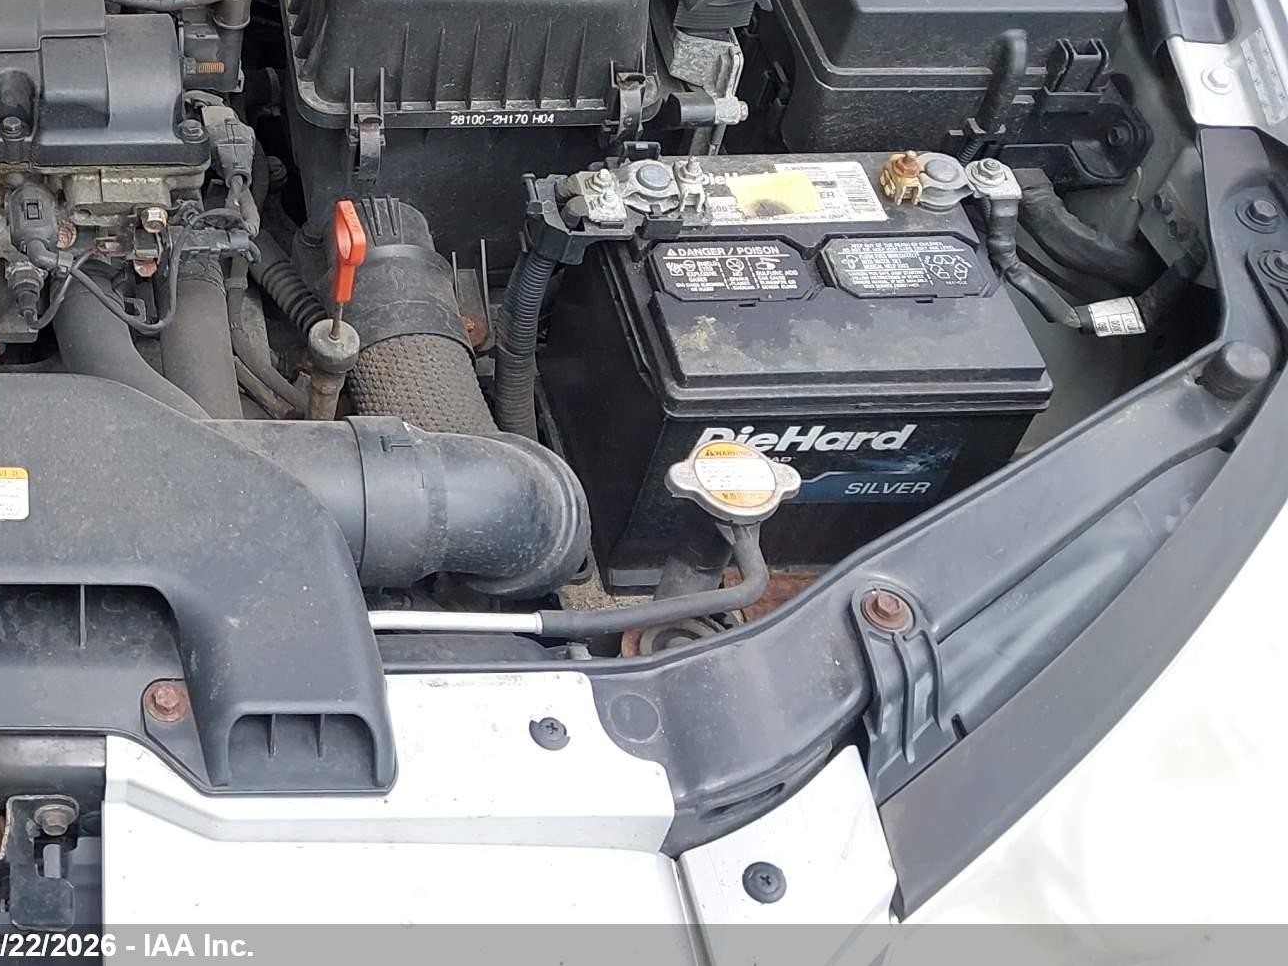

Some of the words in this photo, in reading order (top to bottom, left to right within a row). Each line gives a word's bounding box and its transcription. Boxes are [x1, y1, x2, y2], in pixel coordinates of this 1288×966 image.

[450, 114, 529, 125] 28100-2H170
[532, 113, 555, 124] H04
[678, 247, 725, 257] DANGER
[737, 246, 780, 255] POISON
[695, 424, 917, 452] DieHard
[845, 482, 932, 495] SILVER
